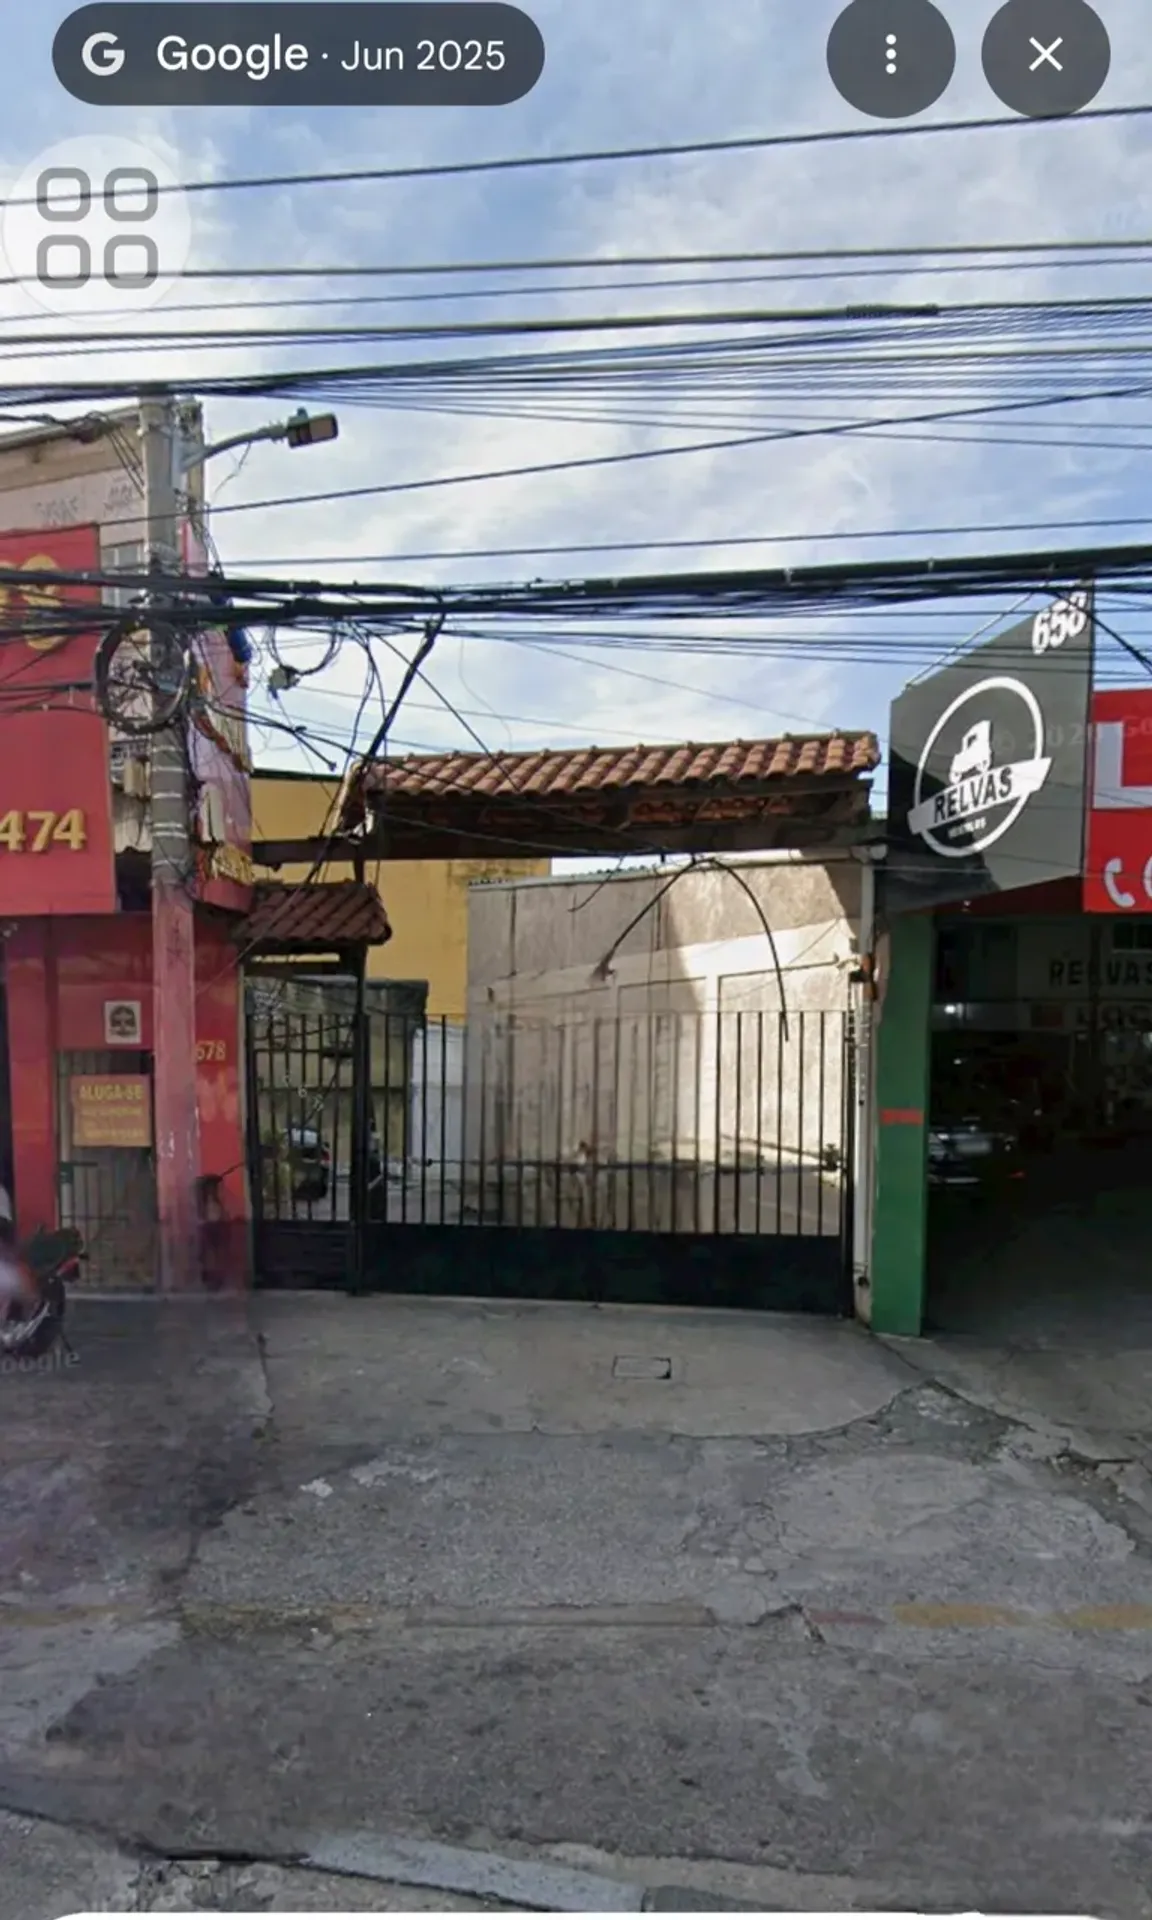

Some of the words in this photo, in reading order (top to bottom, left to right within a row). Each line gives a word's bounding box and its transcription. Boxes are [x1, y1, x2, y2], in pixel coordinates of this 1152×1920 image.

[1032, 591, 1087, 655] 658
[934, 767, 1012, 824] RELVAS
[0, 808, 87, 852] 474
